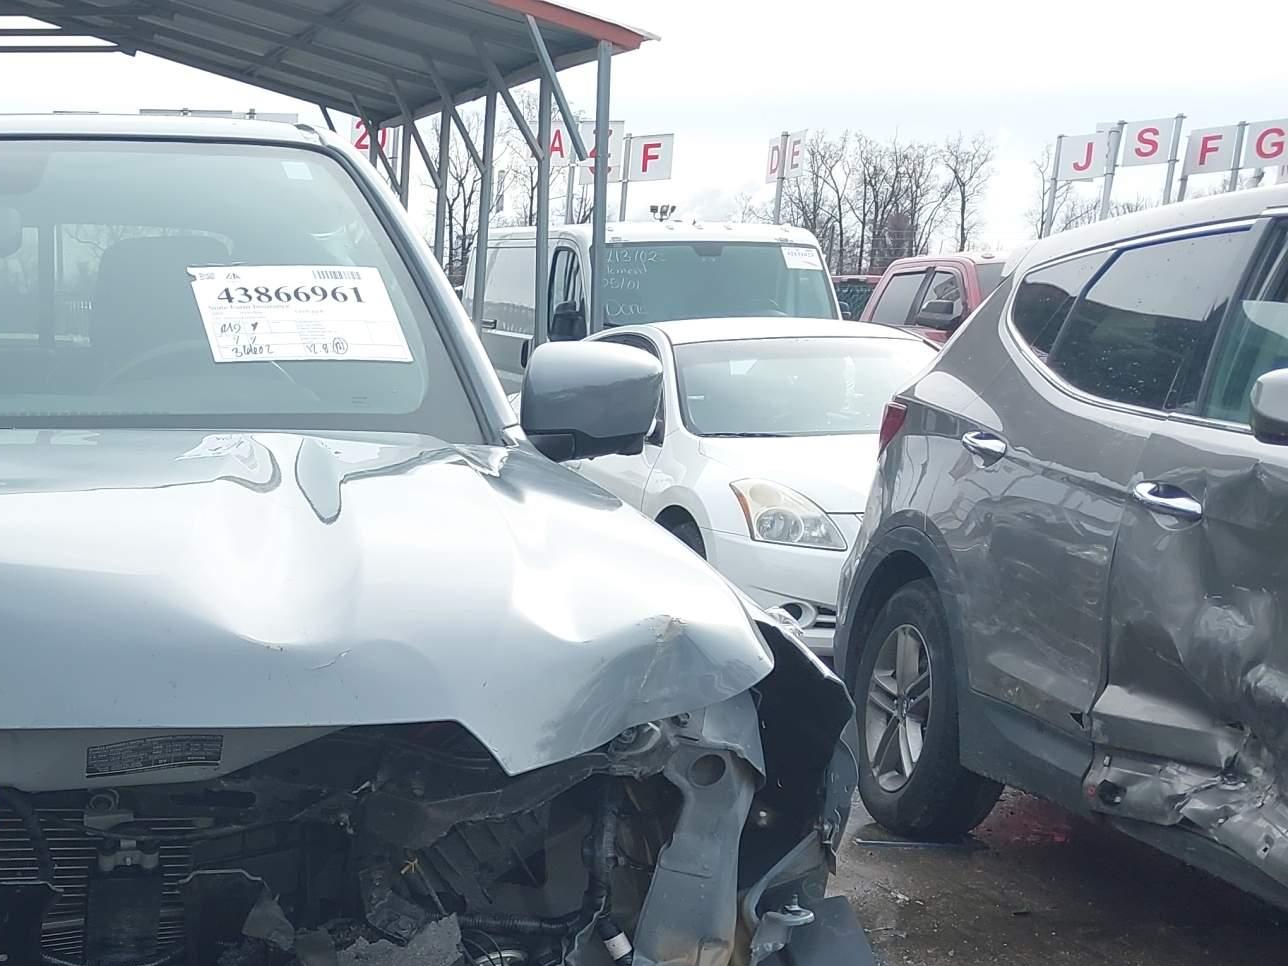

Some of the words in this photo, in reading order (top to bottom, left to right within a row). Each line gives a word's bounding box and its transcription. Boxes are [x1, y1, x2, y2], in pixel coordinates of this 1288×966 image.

[641, 142, 662, 173] F
[790, 139, 802, 169] E
[1072, 141, 1094, 172] J
[1134, 127, 1160, 158] S
[1198, 134, 1223, 166] F
[1255, 127, 1285, 159] G
[769, 144, 780, 175] D
[217, 285, 366, 304] 43866961
